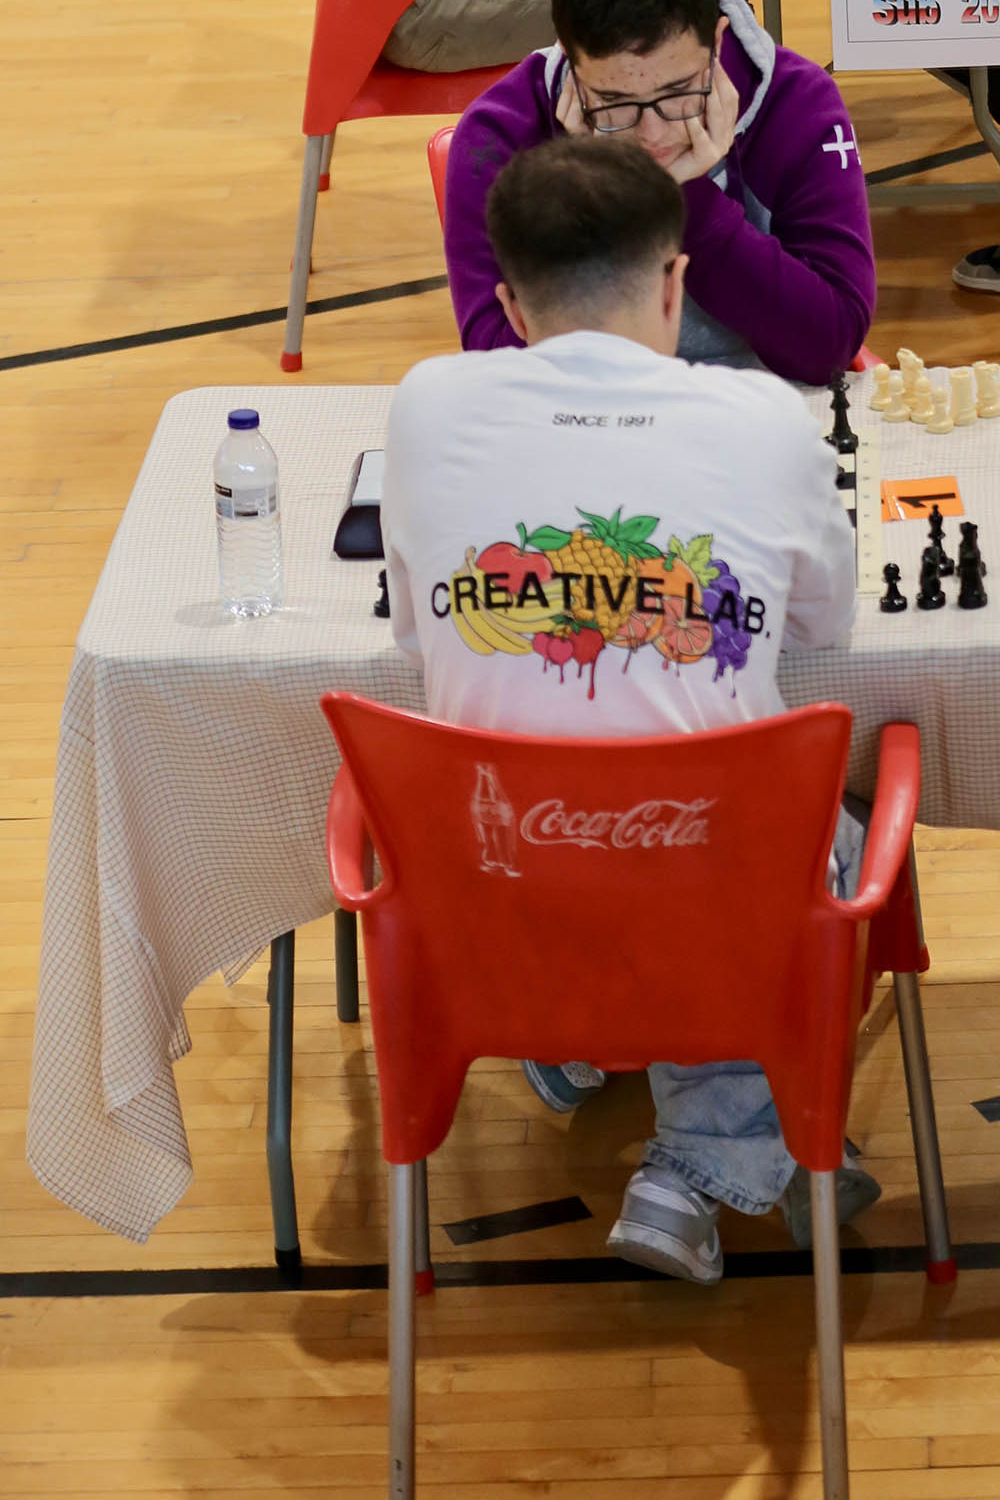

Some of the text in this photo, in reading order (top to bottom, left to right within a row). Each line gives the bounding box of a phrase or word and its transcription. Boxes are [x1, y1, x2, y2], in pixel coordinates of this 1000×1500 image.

[552, 412, 608, 428] SINCE
[431, 572, 771, 639] CREATIVE LAB.
[519, 798, 719, 850] Coca-Cola
